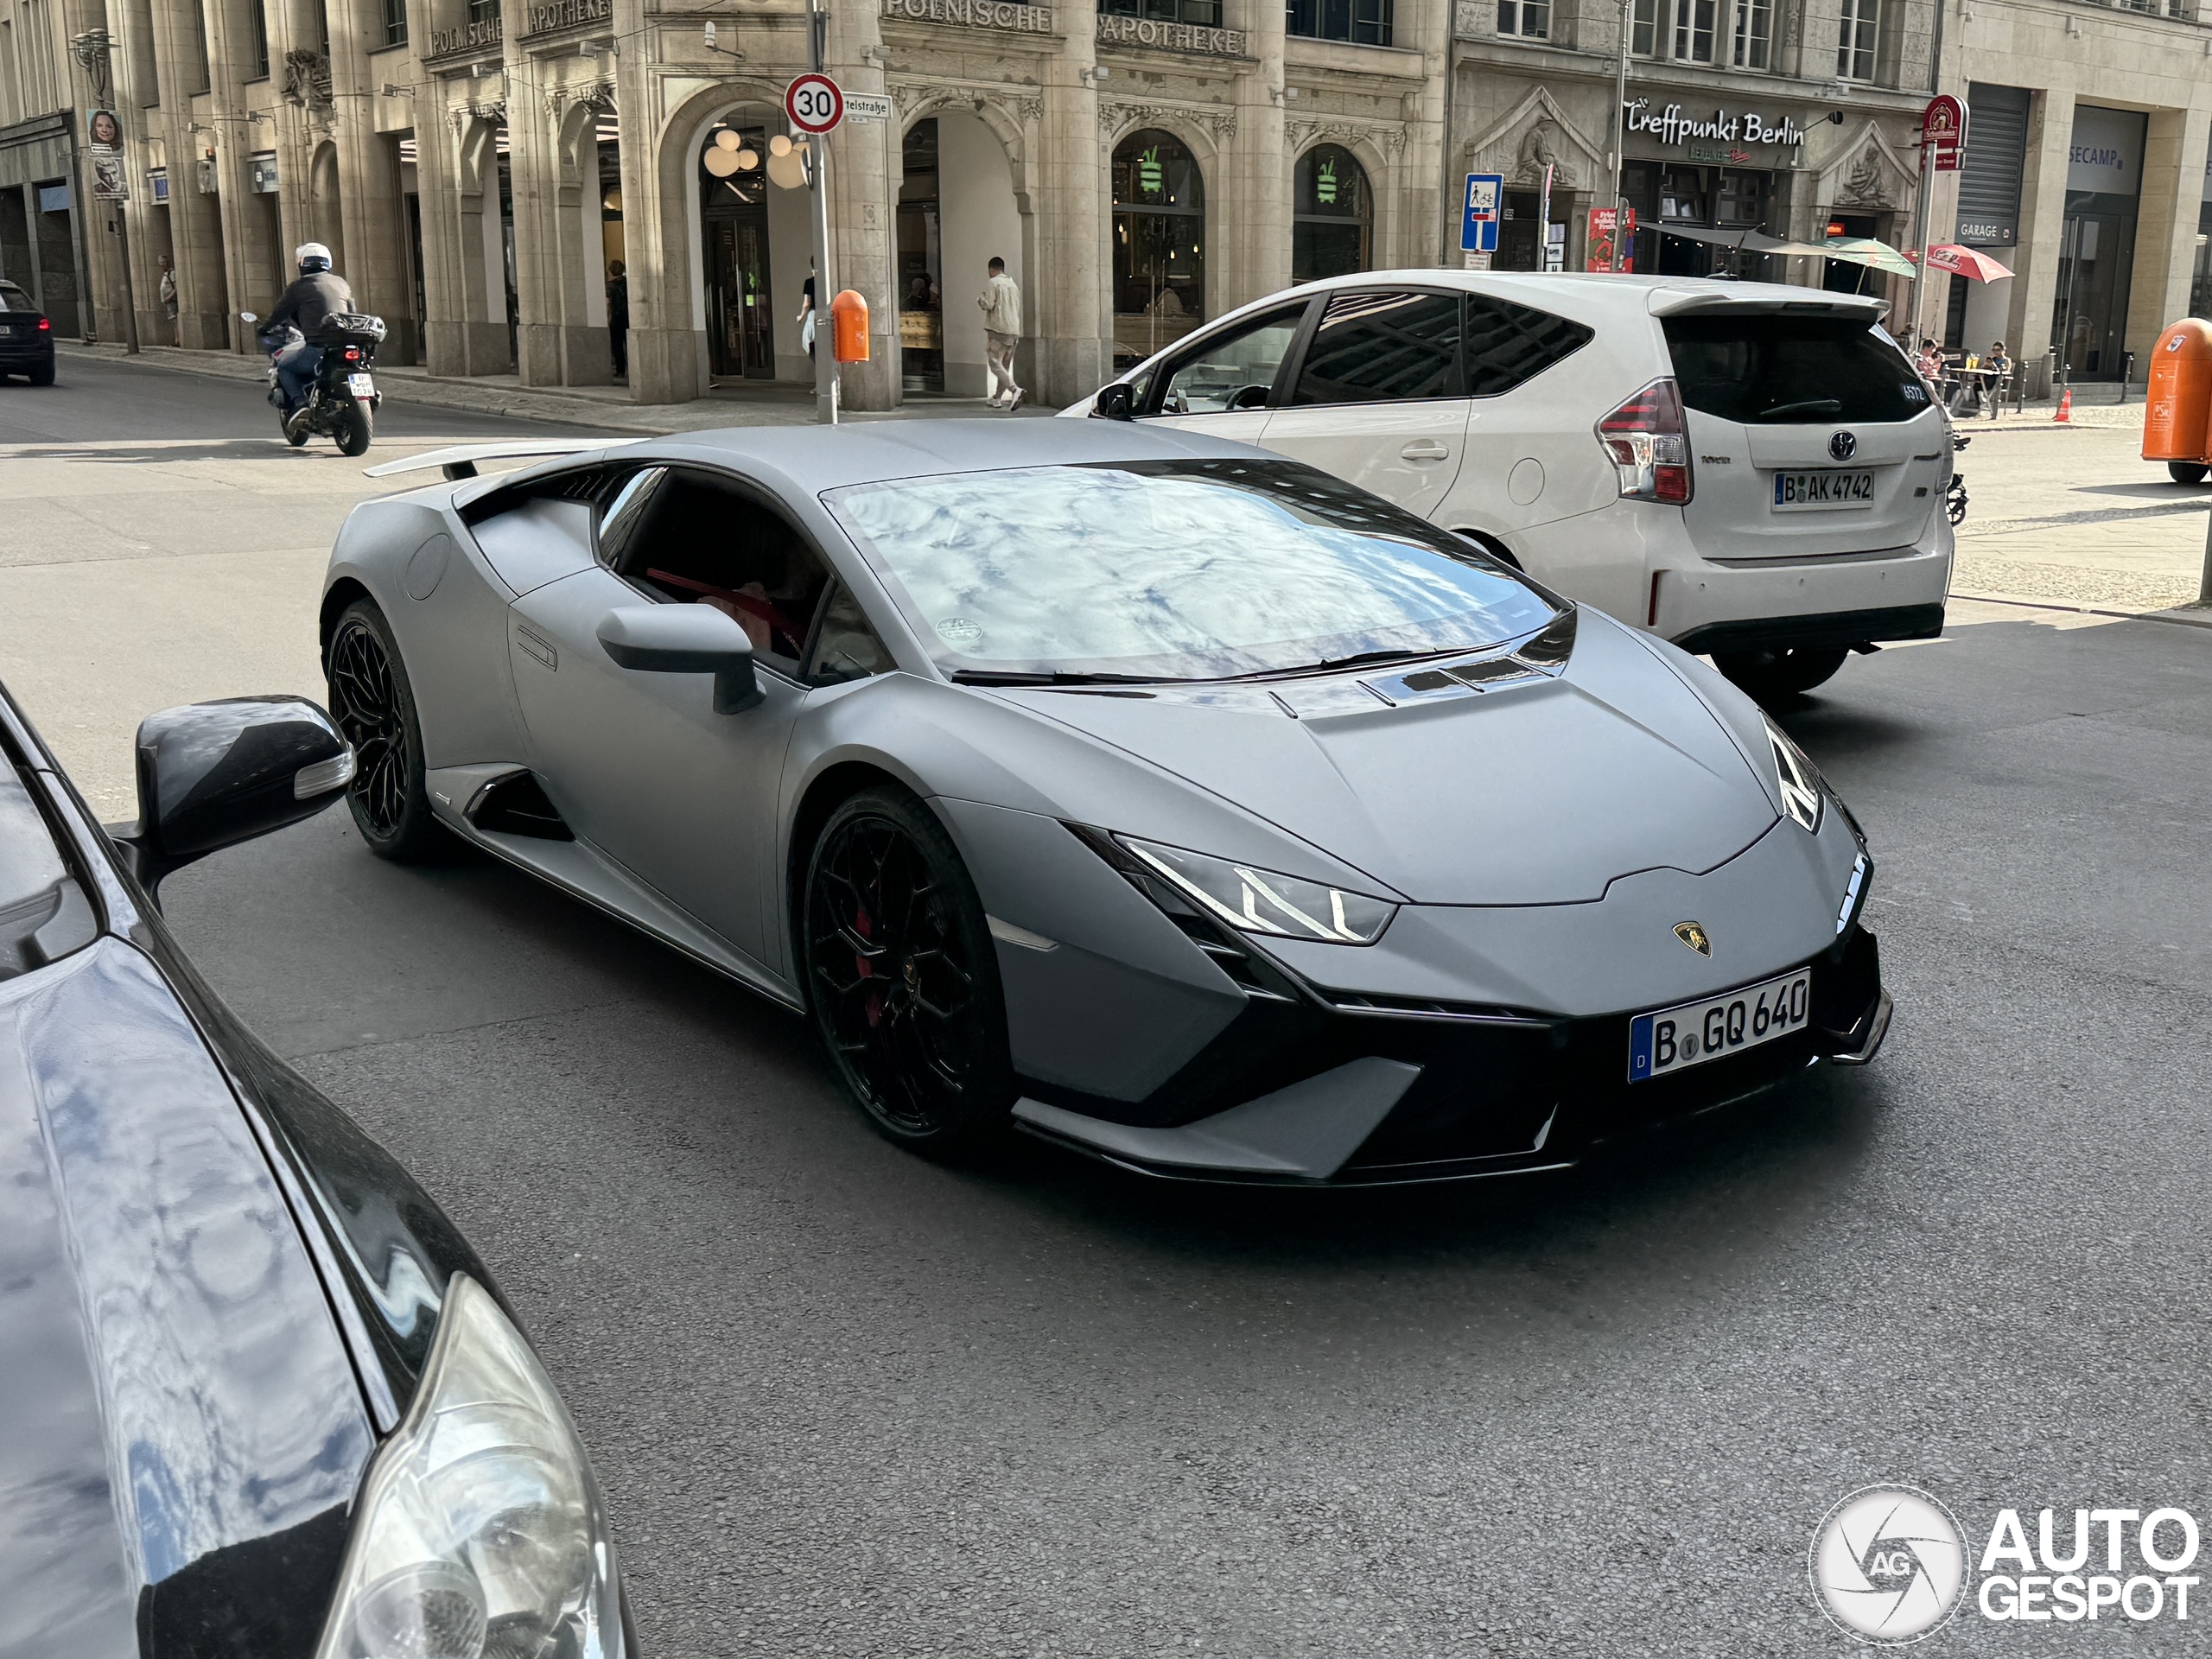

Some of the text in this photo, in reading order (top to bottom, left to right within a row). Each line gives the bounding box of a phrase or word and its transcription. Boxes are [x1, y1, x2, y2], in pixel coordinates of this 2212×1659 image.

[530, 0, 608, 32] APOTHEKE
[887, 0, 1243, 54] POLNISCHE APOTHEKE
[798, 90, 831, 118] 30
[846, 99, 887, 115] telstraße
[1624, 98, 1804, 146] Treffpunkt Berlin
[2069, 145, 2118, 167] SECAMP
[1961, 223, 1998, 238] GARAGE
[1903, 385, 1925, 401] 6572
[1785, 477, 1796, 502] B
[1808, 474, 1829, 500] AK
[1833, 474, 1871, 499] 4742
[1637, 978, 1808, 1068] D B GQ 640
